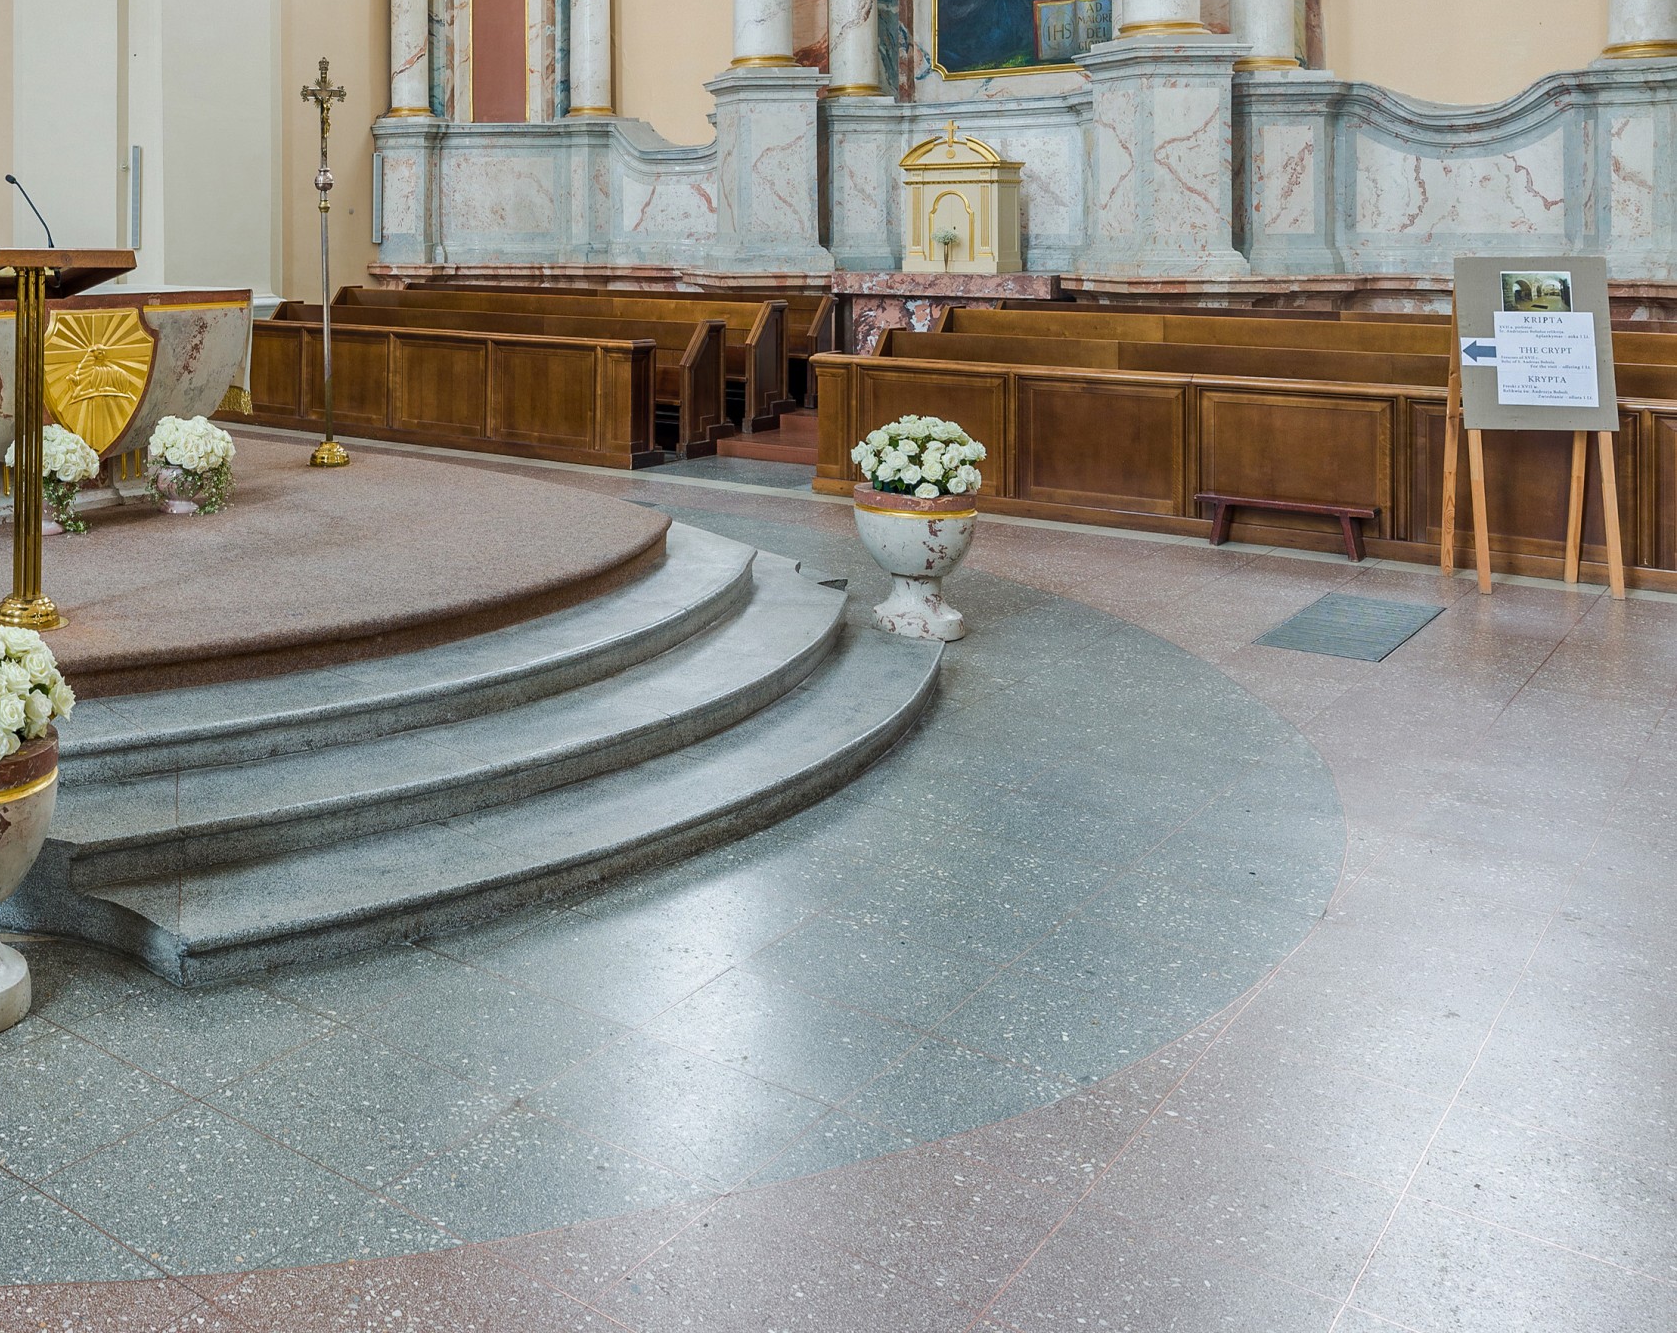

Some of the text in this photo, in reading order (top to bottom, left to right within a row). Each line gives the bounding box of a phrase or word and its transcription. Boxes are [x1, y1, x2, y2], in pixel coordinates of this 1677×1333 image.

[1086, 2, 1103, 14] AD
[1047, 23, 1072, 42] IHS
[1086, 26, 1106, 39] DEI
[1523, 316, 1563, 324] KRIPTA
[1519, 346, 1572, 354] THE CRYPT
[1528, 375, 1567, 383] KRYPTA
